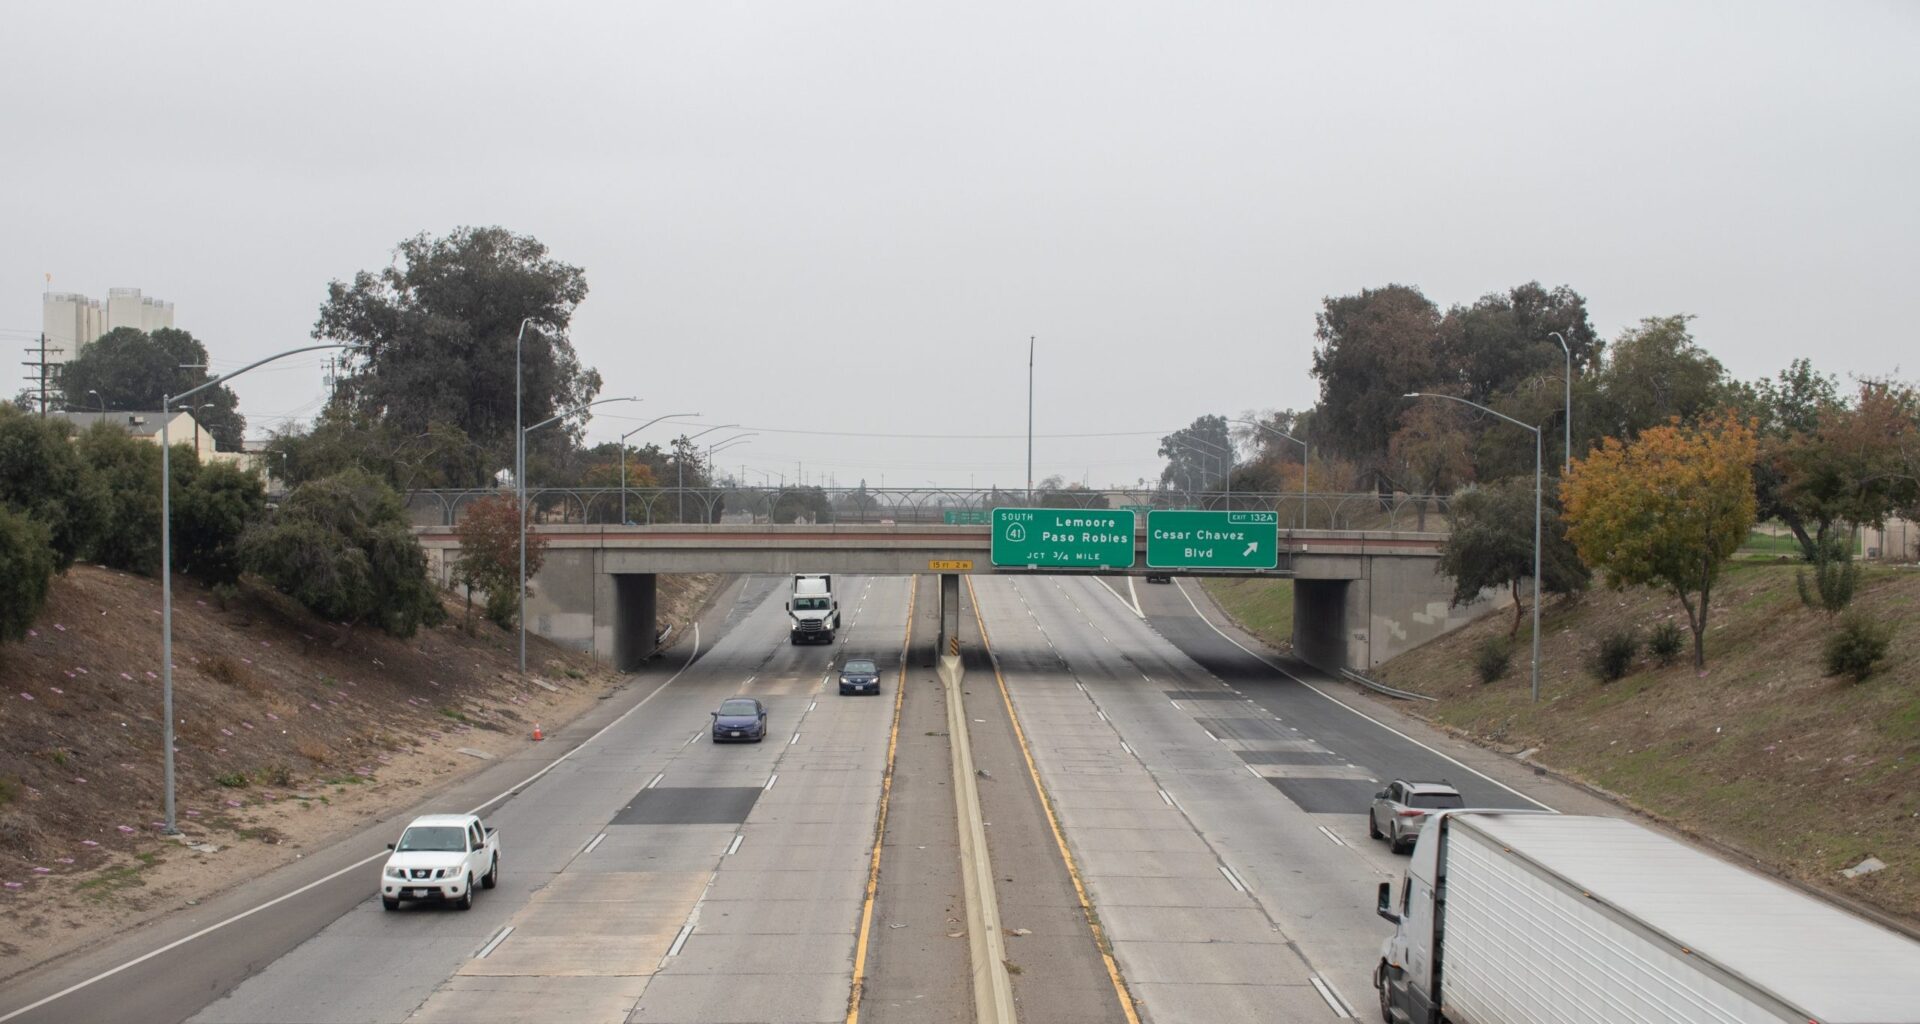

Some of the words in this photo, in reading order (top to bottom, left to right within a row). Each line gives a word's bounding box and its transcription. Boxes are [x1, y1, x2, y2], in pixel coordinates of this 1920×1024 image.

[1002, 513, 1033, 521] SOUTH
[1056, 517, 1115, 527] Lemoore
[1010, 529, 1021, 538] 41
[1042, 532, 1075, 542] Paso
[1082, 532, 1128, 543] Robles
[1154, 529, 1190, 539] Cesar
[1197, 530, 1244, 540] Chavez
[1185, 548, 1213, 558] Blvd
